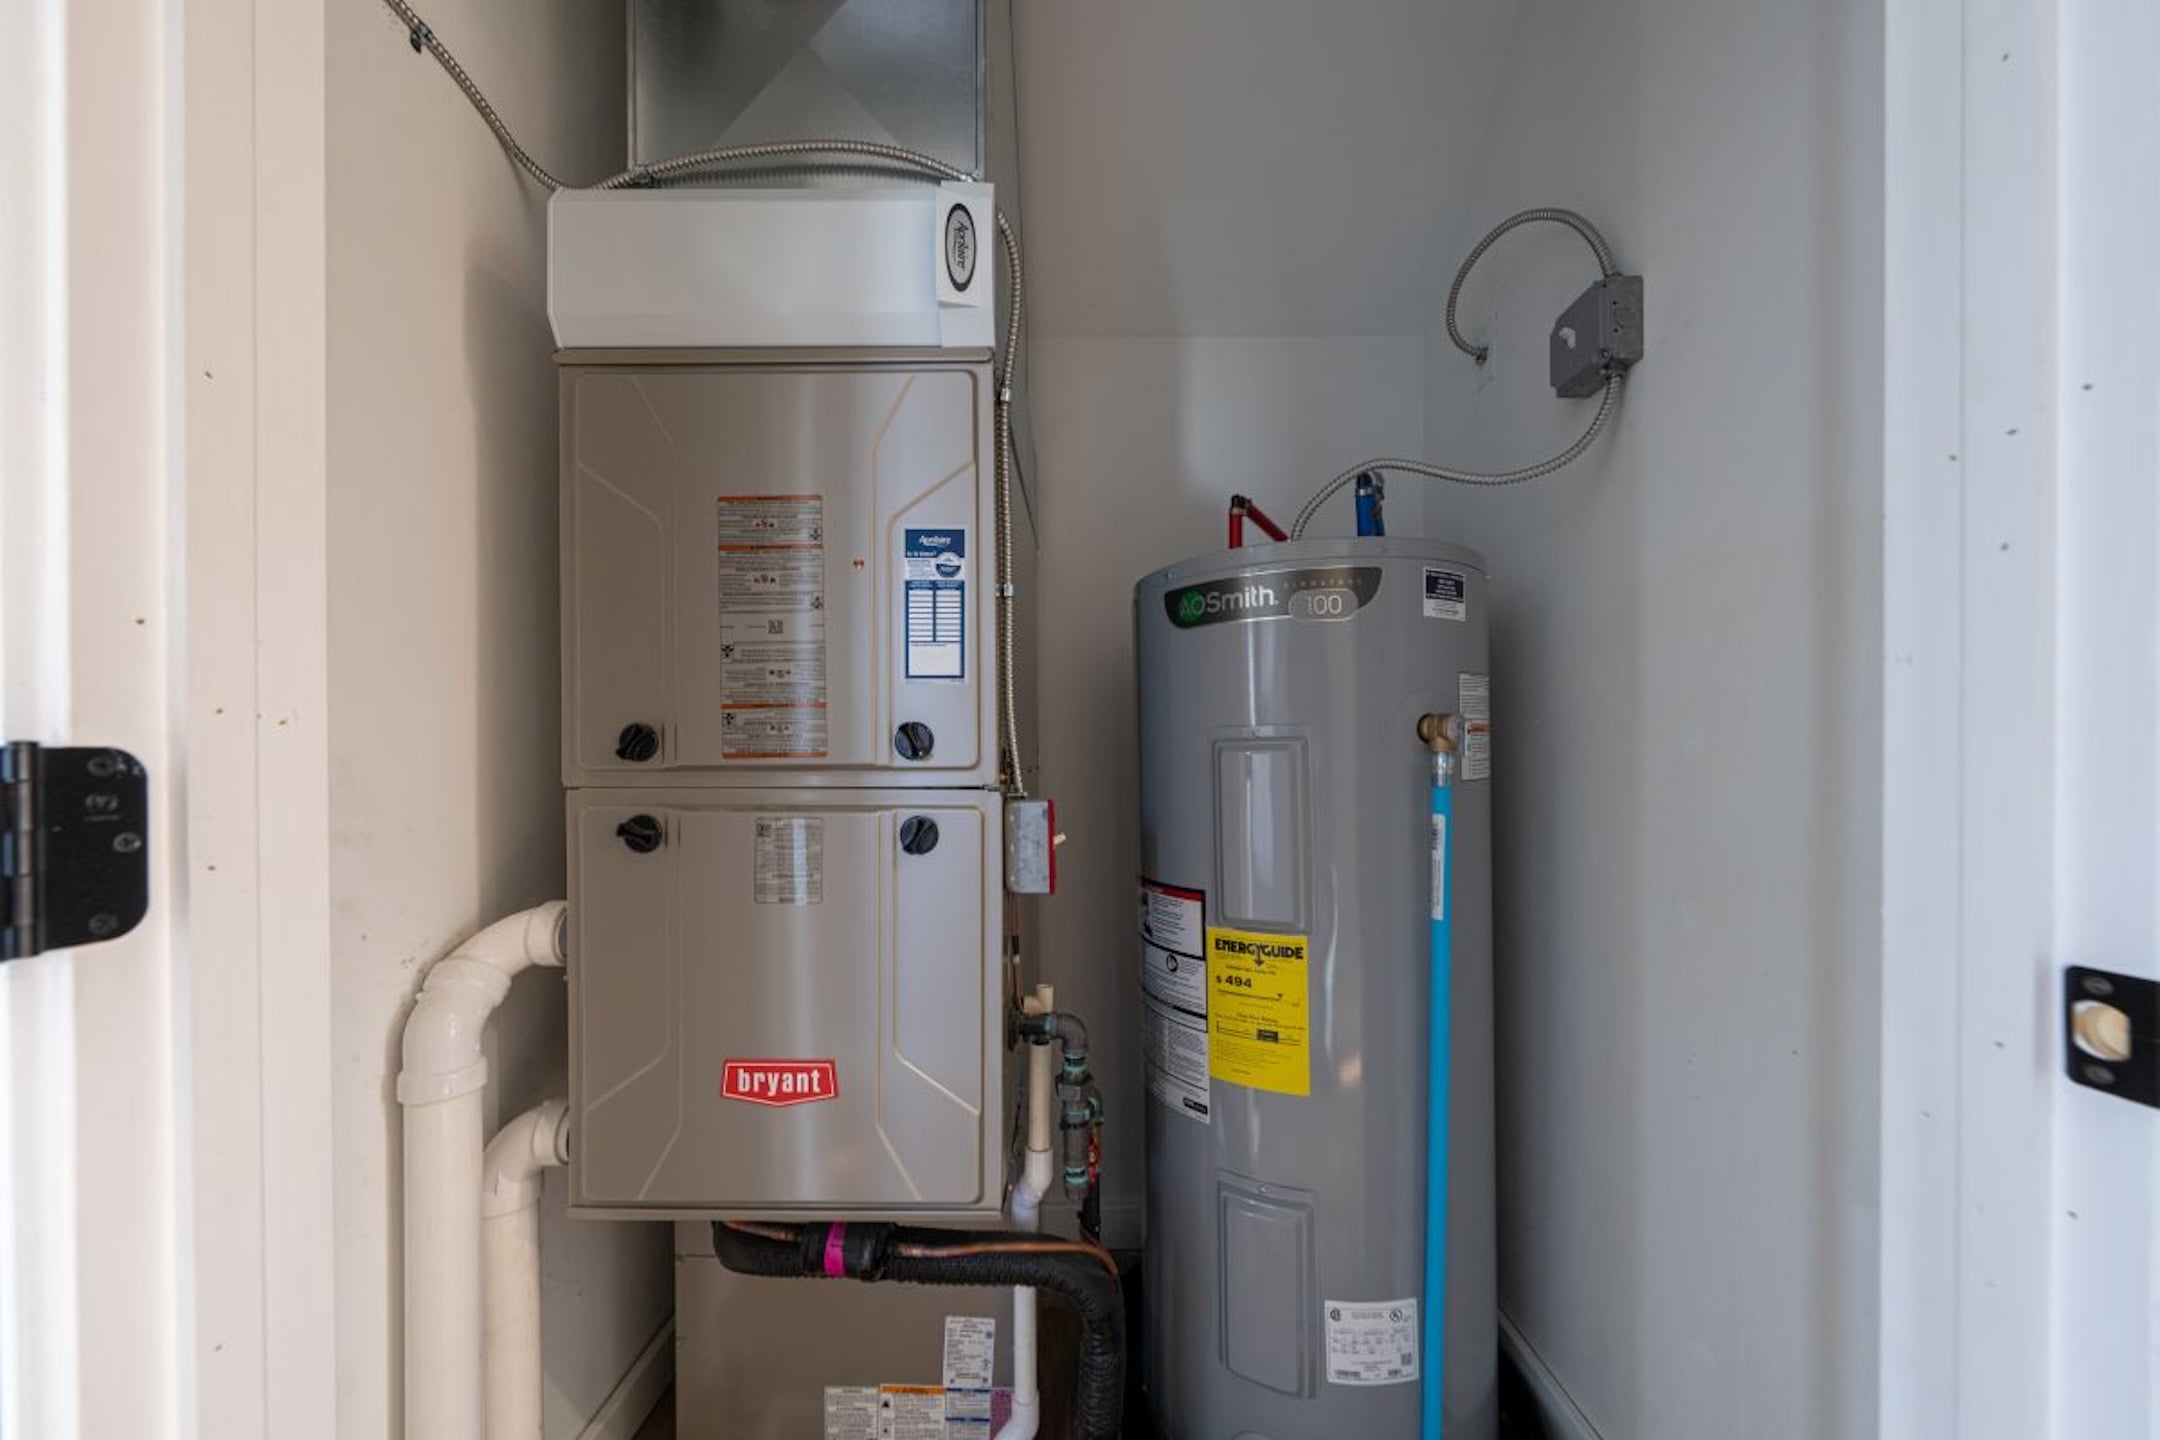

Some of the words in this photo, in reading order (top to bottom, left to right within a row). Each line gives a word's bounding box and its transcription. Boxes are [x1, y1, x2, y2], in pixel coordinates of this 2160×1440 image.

[1308, 594, 1342, 615] 100
[1225, 974, 1253, 988] 494
[737, 1068, 821, 1097] bryant
